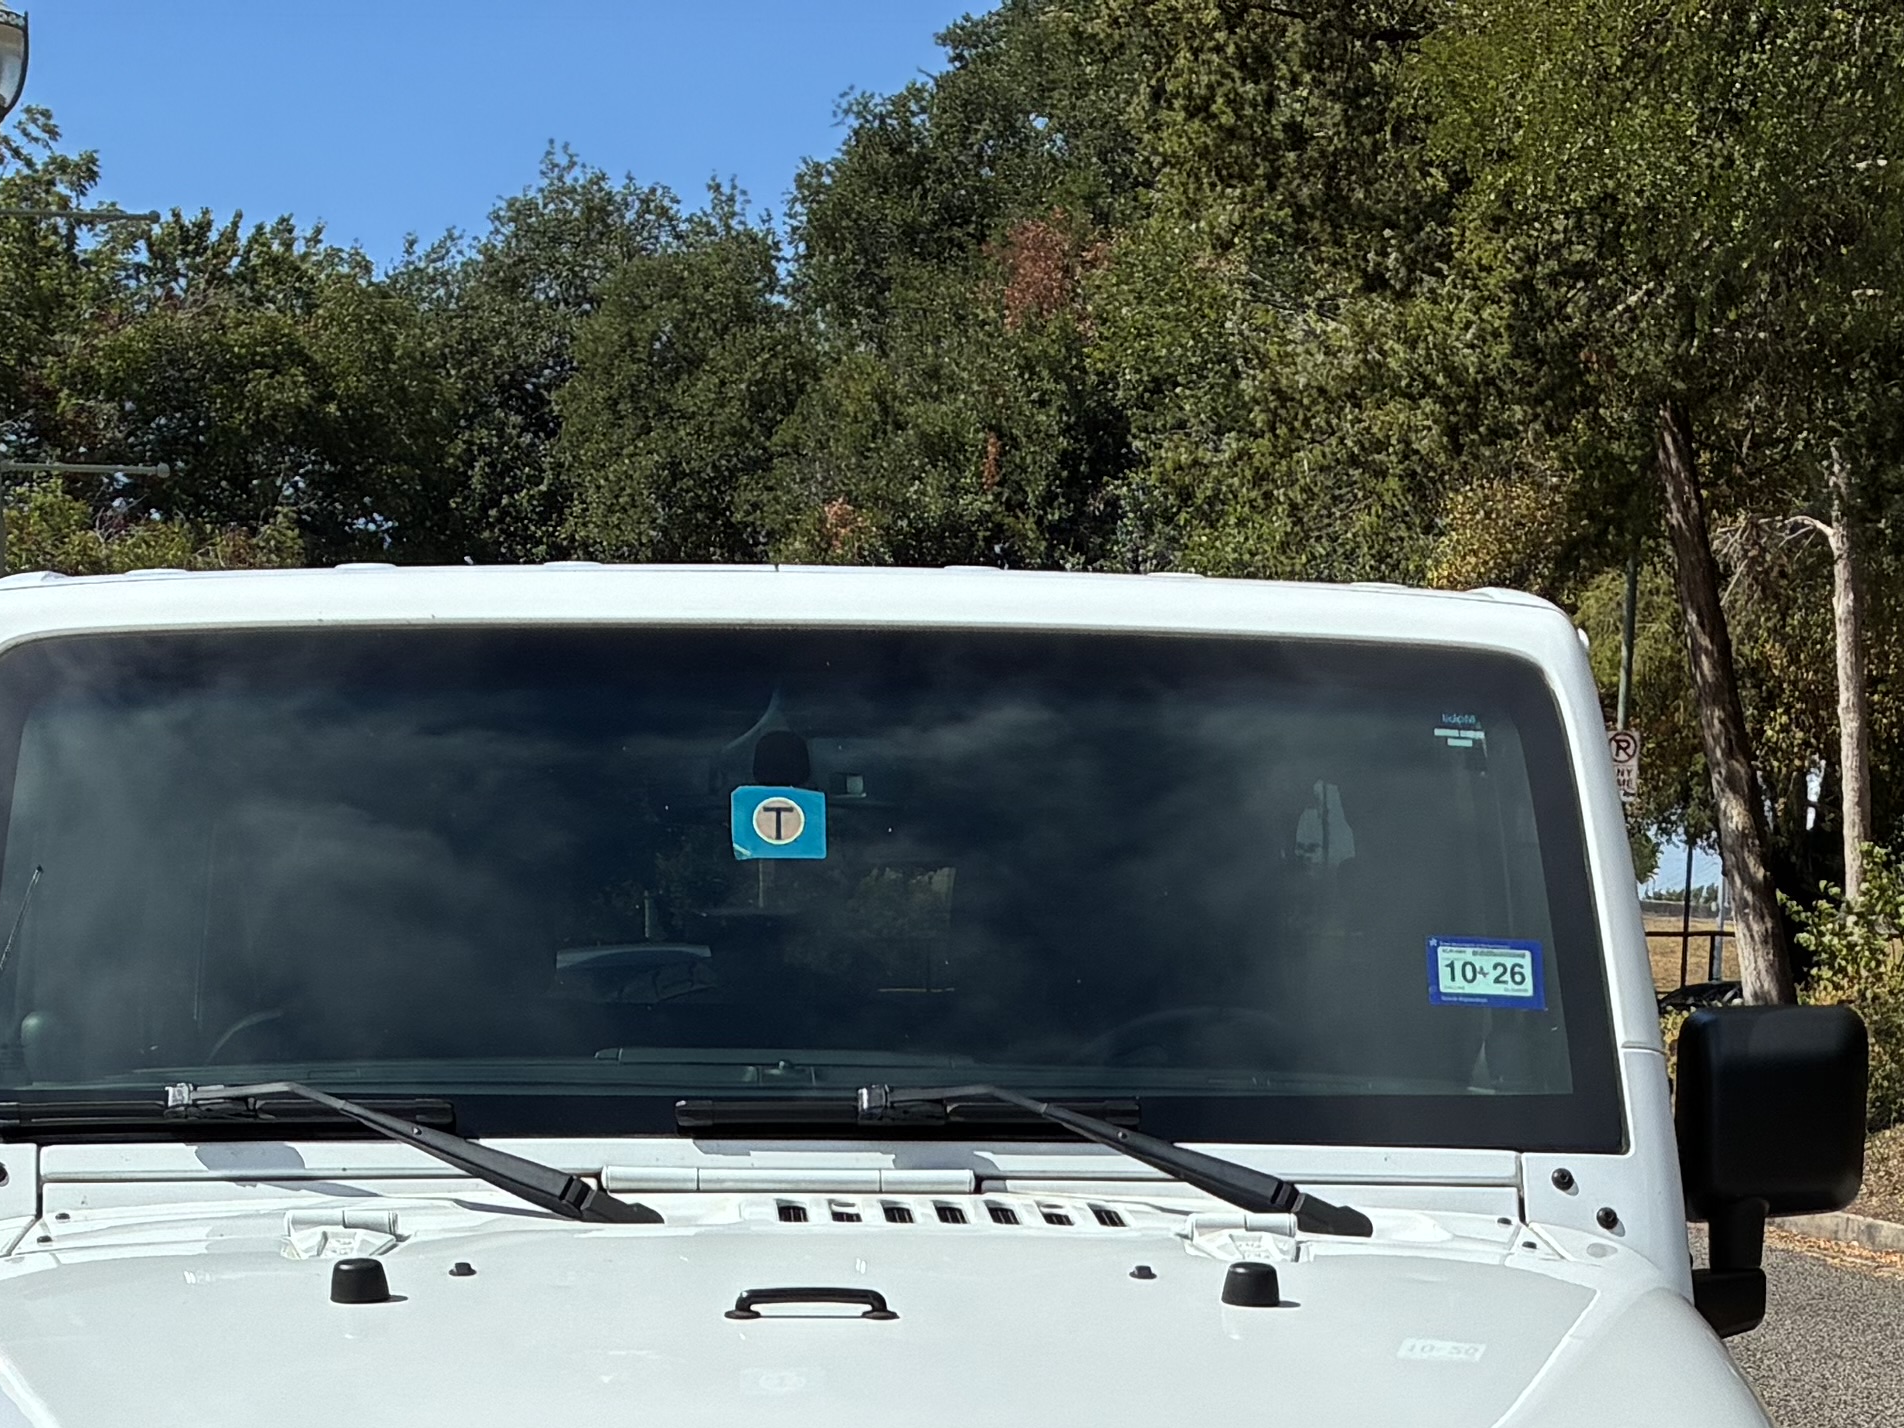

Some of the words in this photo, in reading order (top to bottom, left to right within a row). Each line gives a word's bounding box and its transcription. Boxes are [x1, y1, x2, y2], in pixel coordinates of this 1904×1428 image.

[762, 806, 794, 840] T
[1444, 959, 1477, 984] 10
[1492, 961, 1526, 986] 26
